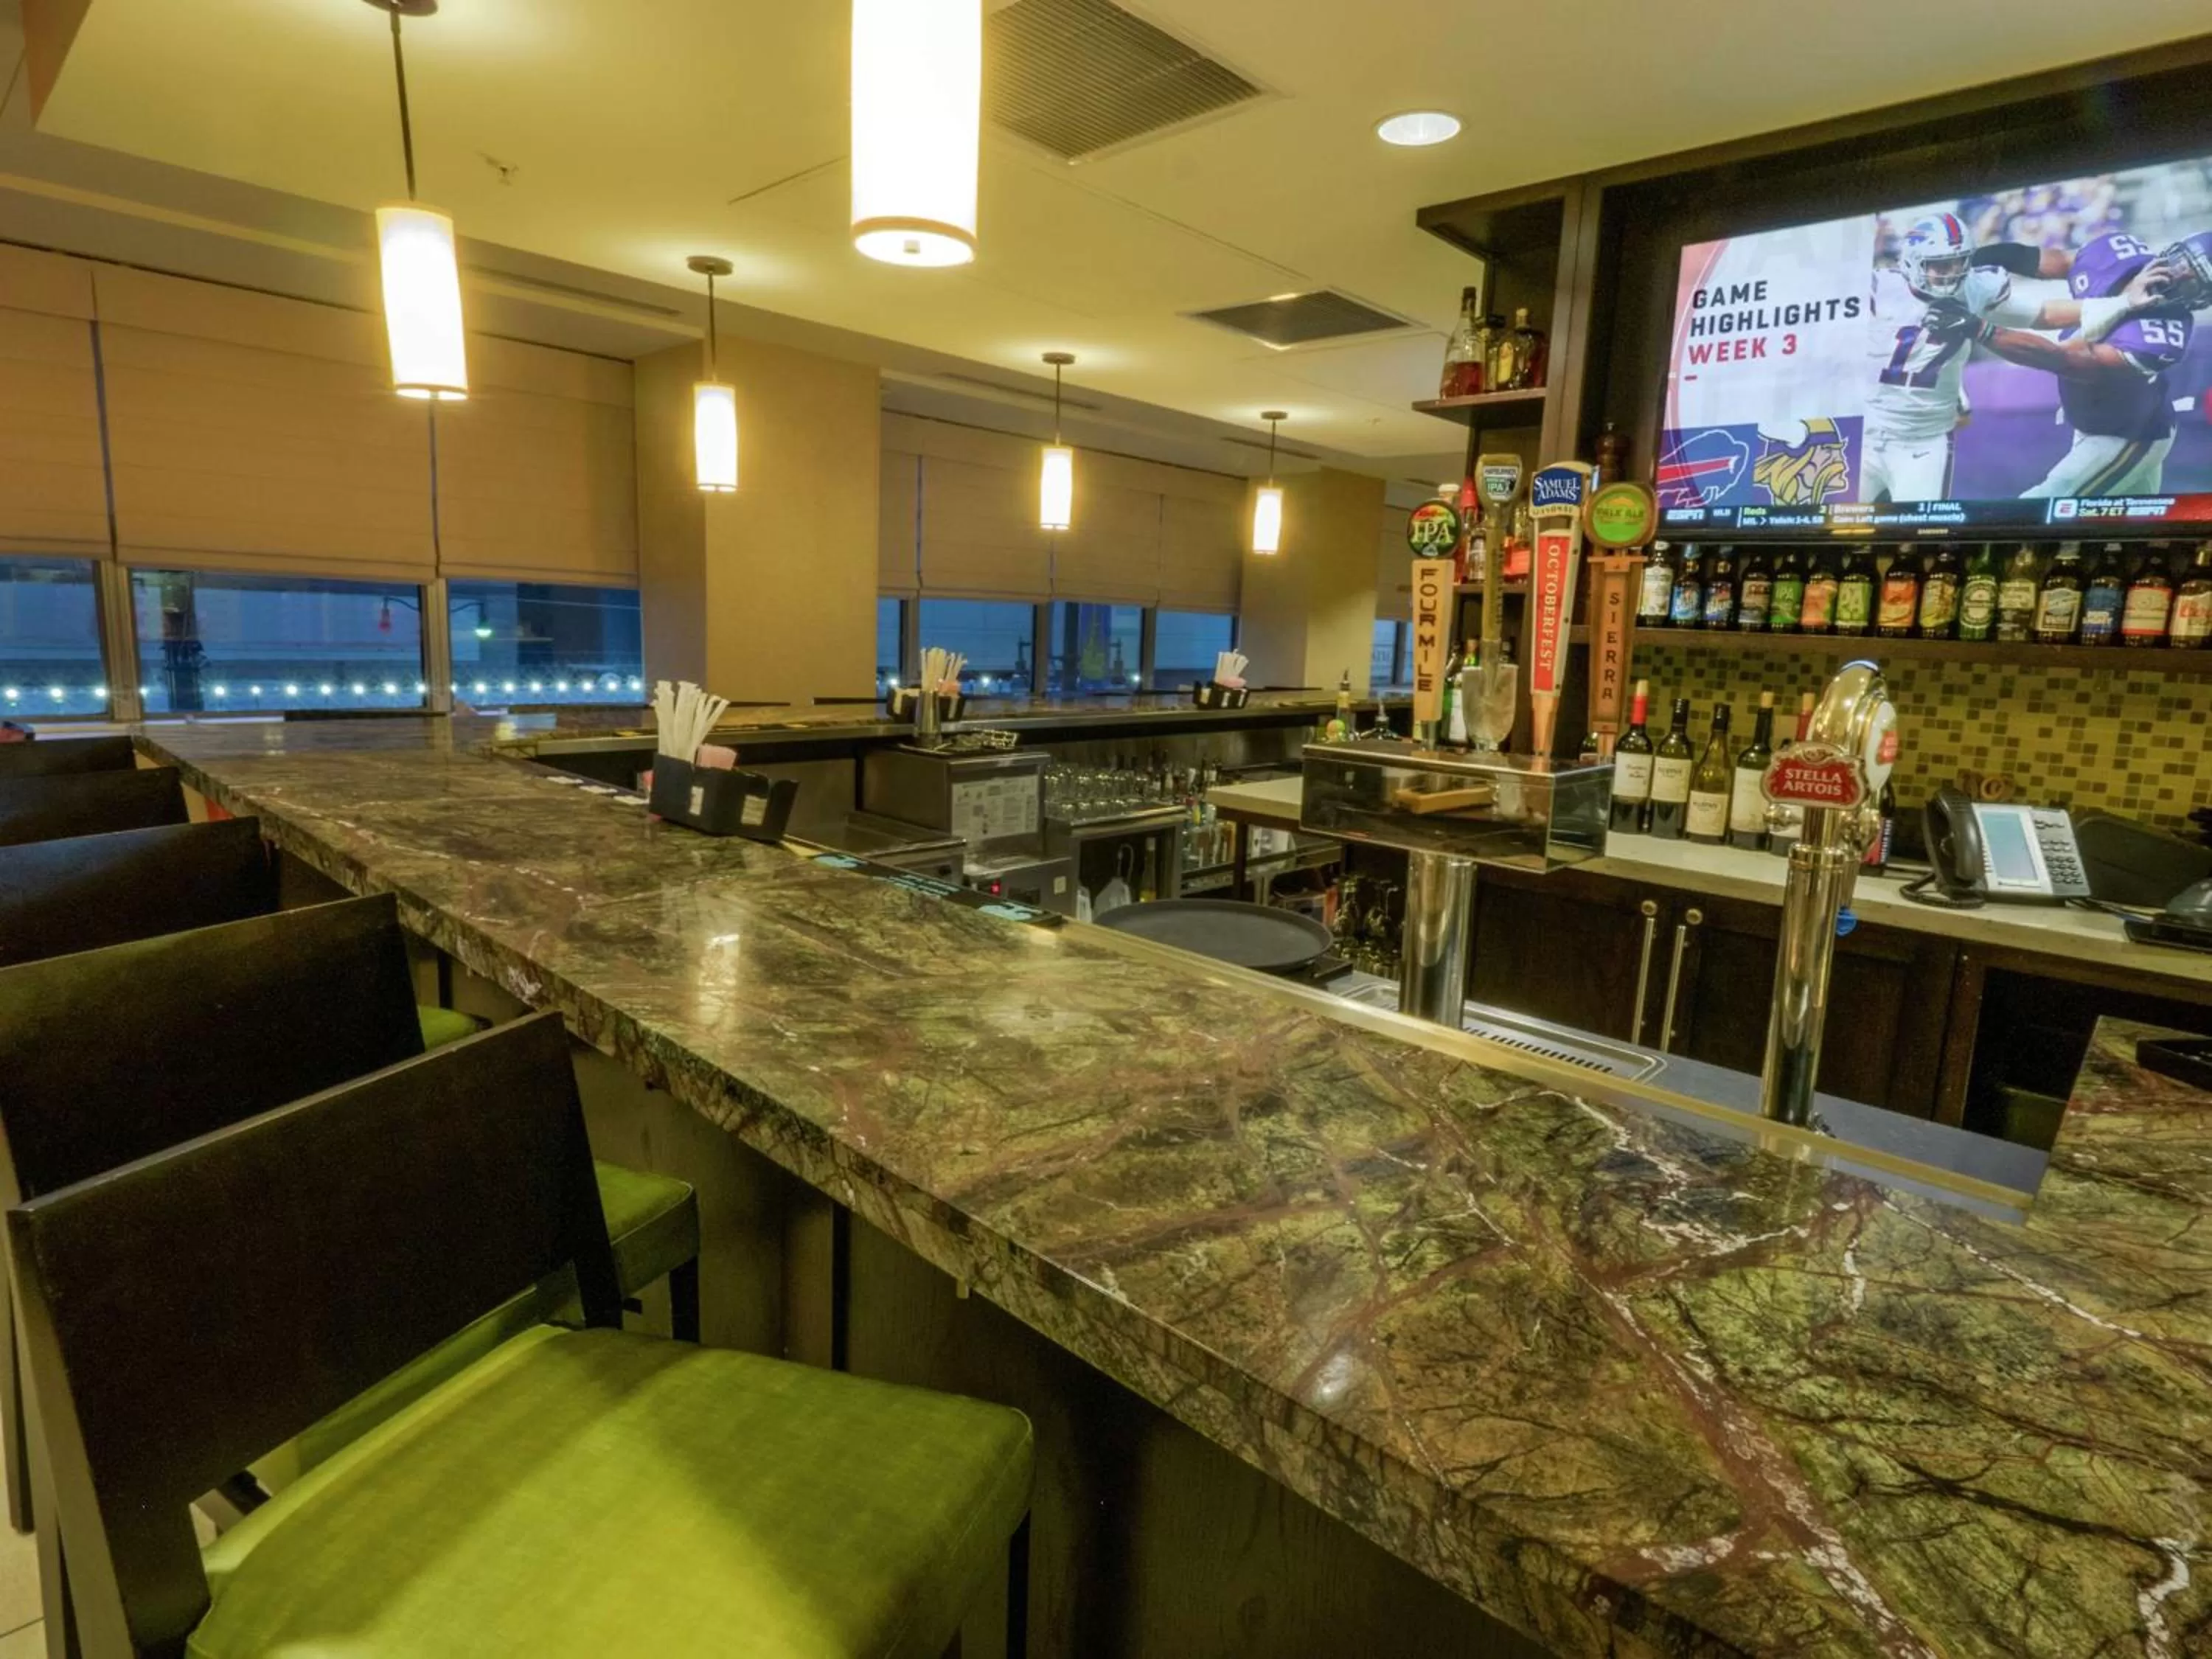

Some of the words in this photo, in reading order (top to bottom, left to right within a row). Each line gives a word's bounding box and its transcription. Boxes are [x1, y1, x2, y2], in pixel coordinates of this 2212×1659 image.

[1692, 280, 1767, 309] GAME
[1690, 296, 1860, 337] HIGHLIGHTS
[2140, 319, 2185, 349] 55
[1688, 336, 1767, 365] WEEK
[1781, 333, 1797, 355] 3
[1487, 483, 1503, 492] IPA
[1534, 476, 1580, 490] SAMUEL
[1537, 486, 1577, 501] ADAMS
[1933, 501, 1962, 511] FINAL
[1411, 521, 1453, 543] IPA
[1419, 568, 1439, 627] FOUR
[1539, 544, 1561, 672] OCTOBERFEST
[1601, 592, 1621, 700] SIERRA
[1417, 634, 1436, 692] MILE
[1782, 779, 1842, 796] ARTOIS
[1784, 768, 1843, 784] STELLA
